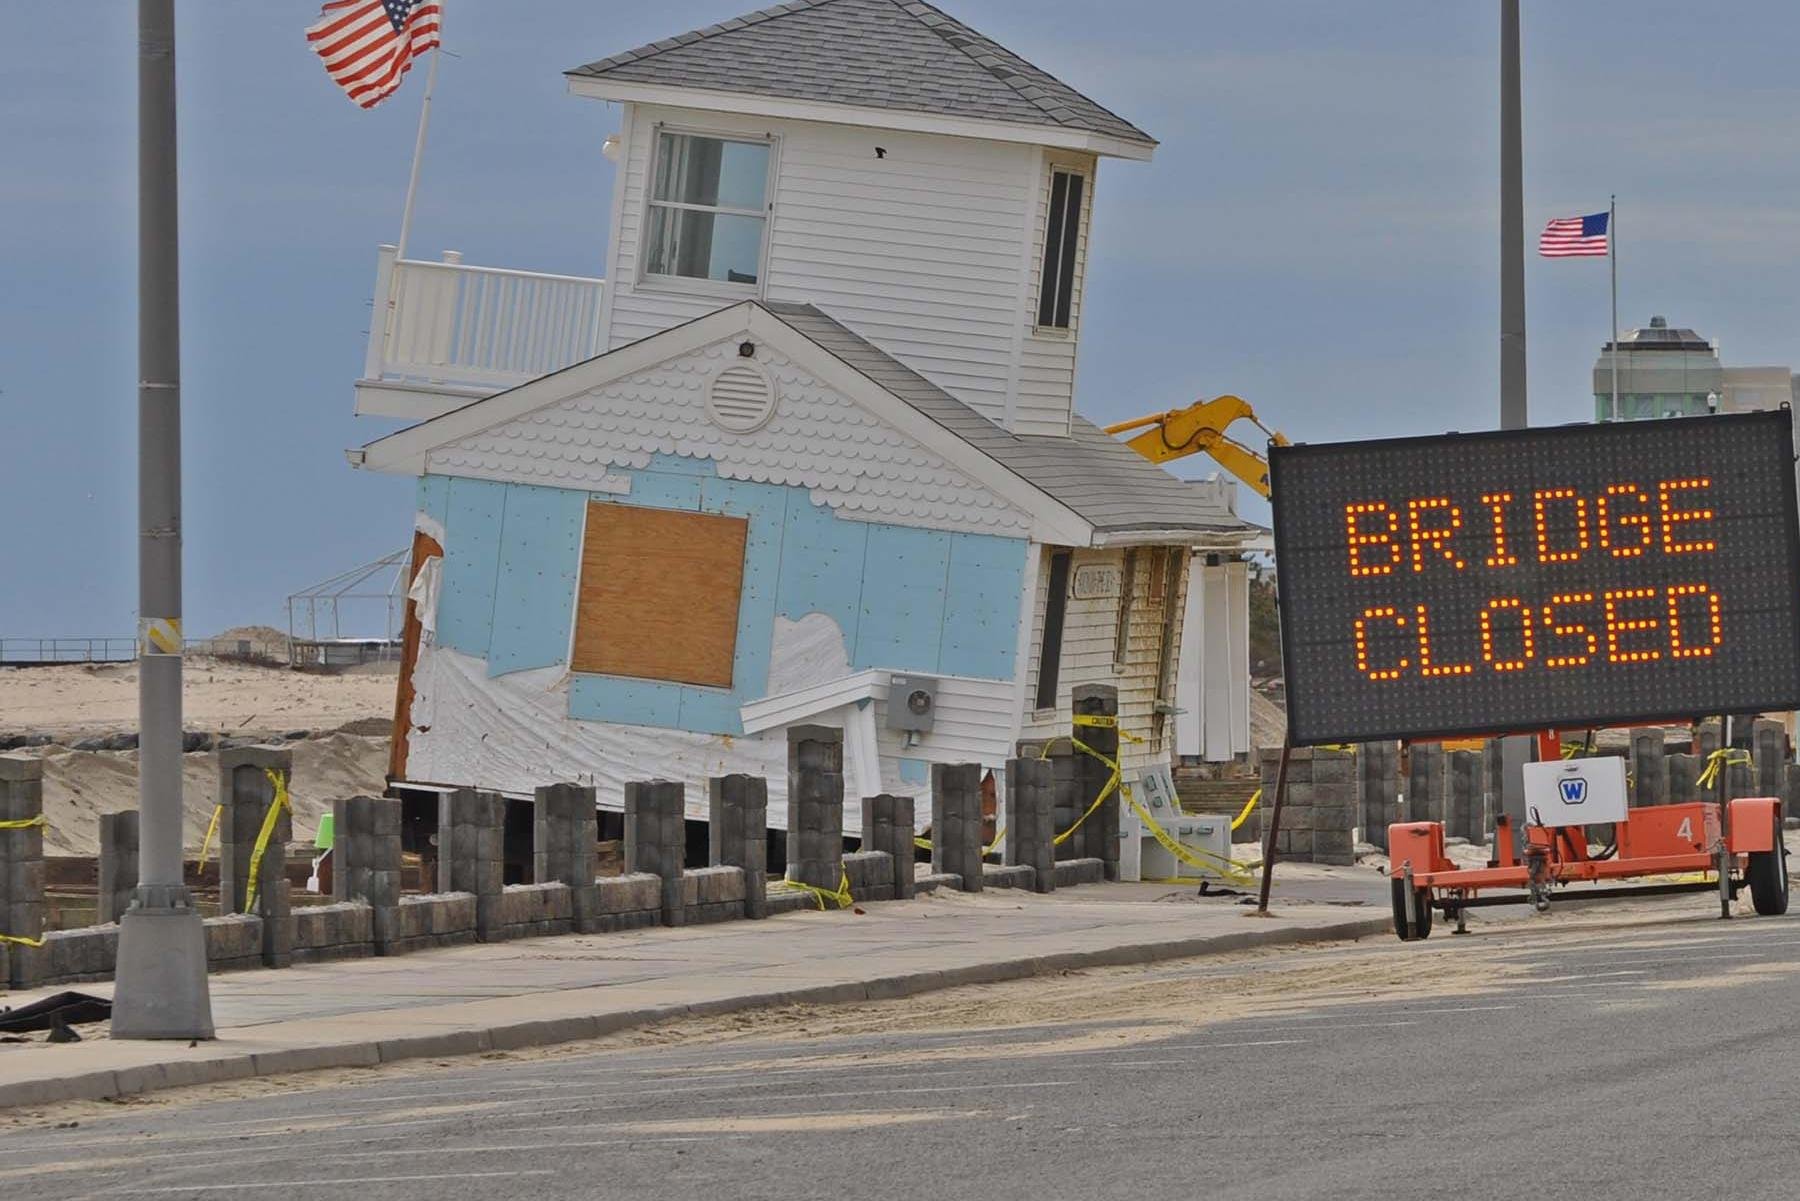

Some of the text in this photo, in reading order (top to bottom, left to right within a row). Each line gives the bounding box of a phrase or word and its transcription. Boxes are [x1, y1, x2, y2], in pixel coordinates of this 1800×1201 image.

[1346, 479, 1715, 576] BRIDGE
[1354, 584, 1721, 679] CLOSED
[1561, 781, 1584, 801] W
[1676, 816, 1693, 842] 4
